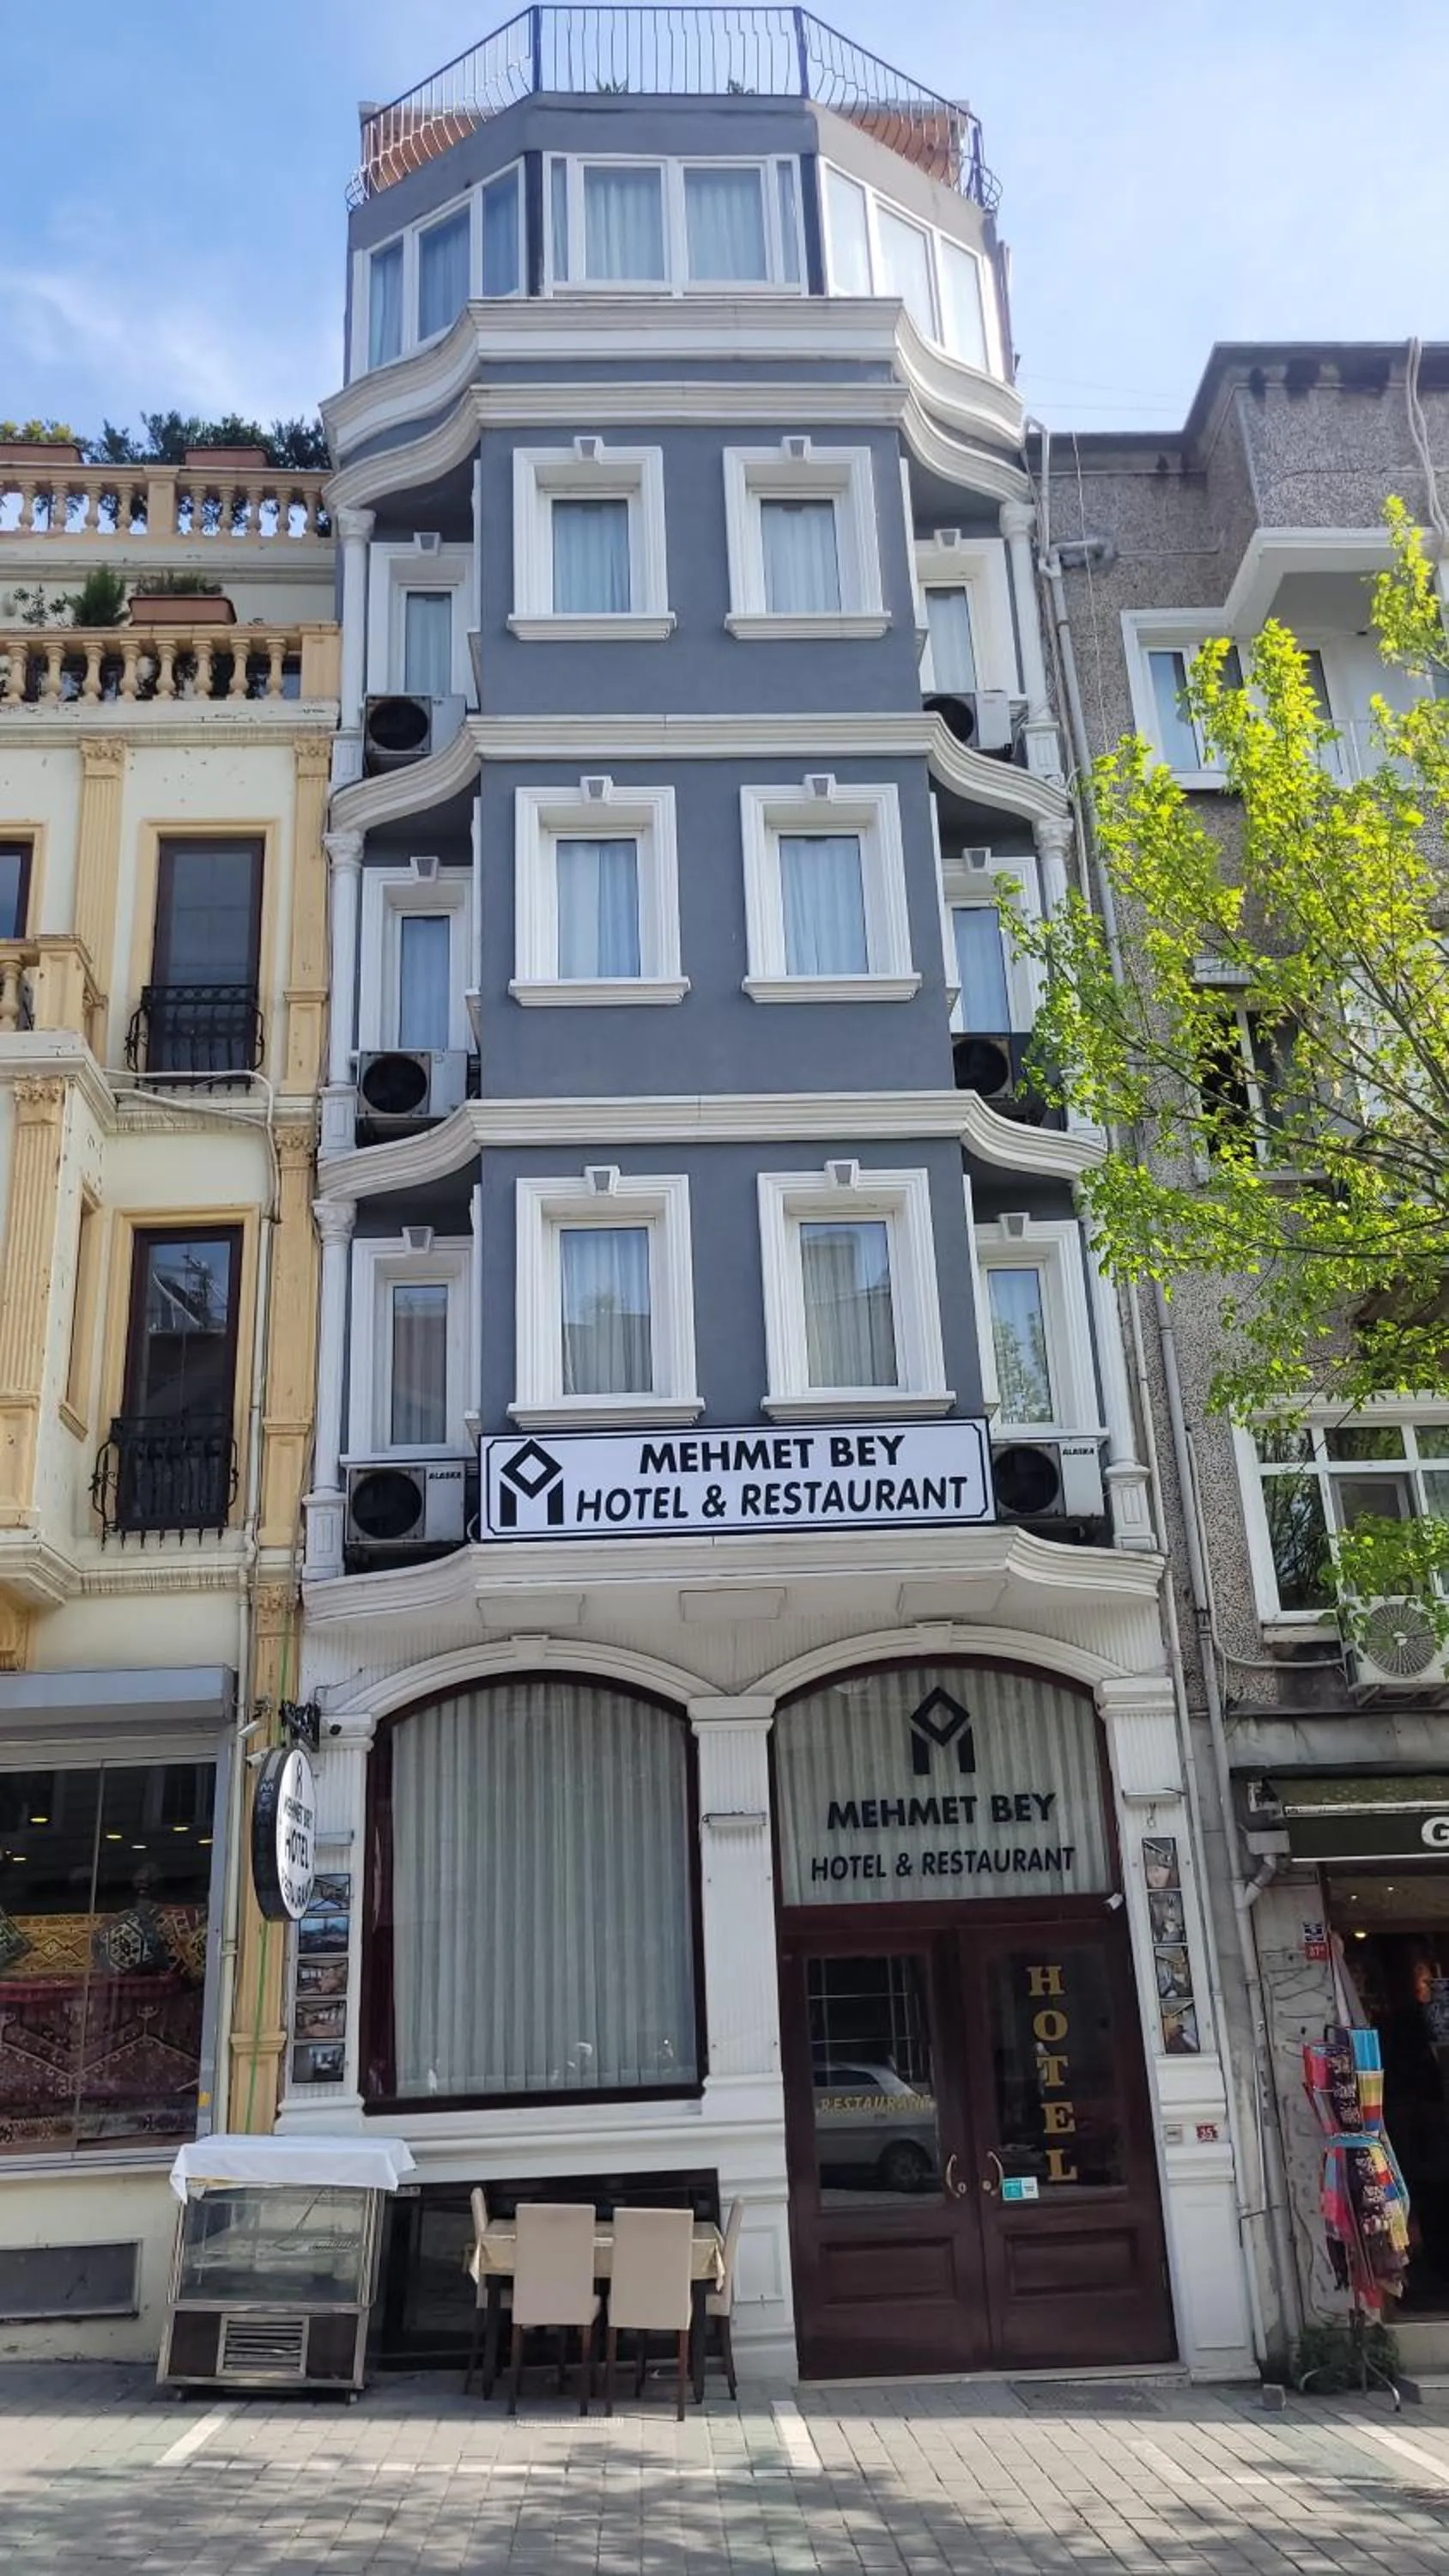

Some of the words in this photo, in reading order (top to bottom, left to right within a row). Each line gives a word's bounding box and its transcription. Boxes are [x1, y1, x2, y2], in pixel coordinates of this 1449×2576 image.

[640, 1437, 815, 1474] MEHMET
[830, 1435, 905, 1467] BEY
[576, 1486, 688, 1522] HOTEL
[701, 1484, 726, 1516] &
[741, 1476, 967, 1516] RESTAURANT
[827, 1796, 978, 1830] MEHMET
[991, 1793, 1056, 1823] BEY
[284, 1828, 308, 1869] HOTEL
[811, 1854, 887, 1881] HOTEL
[895, 1852, 912, 1876] &
[922, 1847, 1076, 1875] RESTAURANT
[1027, 1965, 1077, 2182] HOTEL
